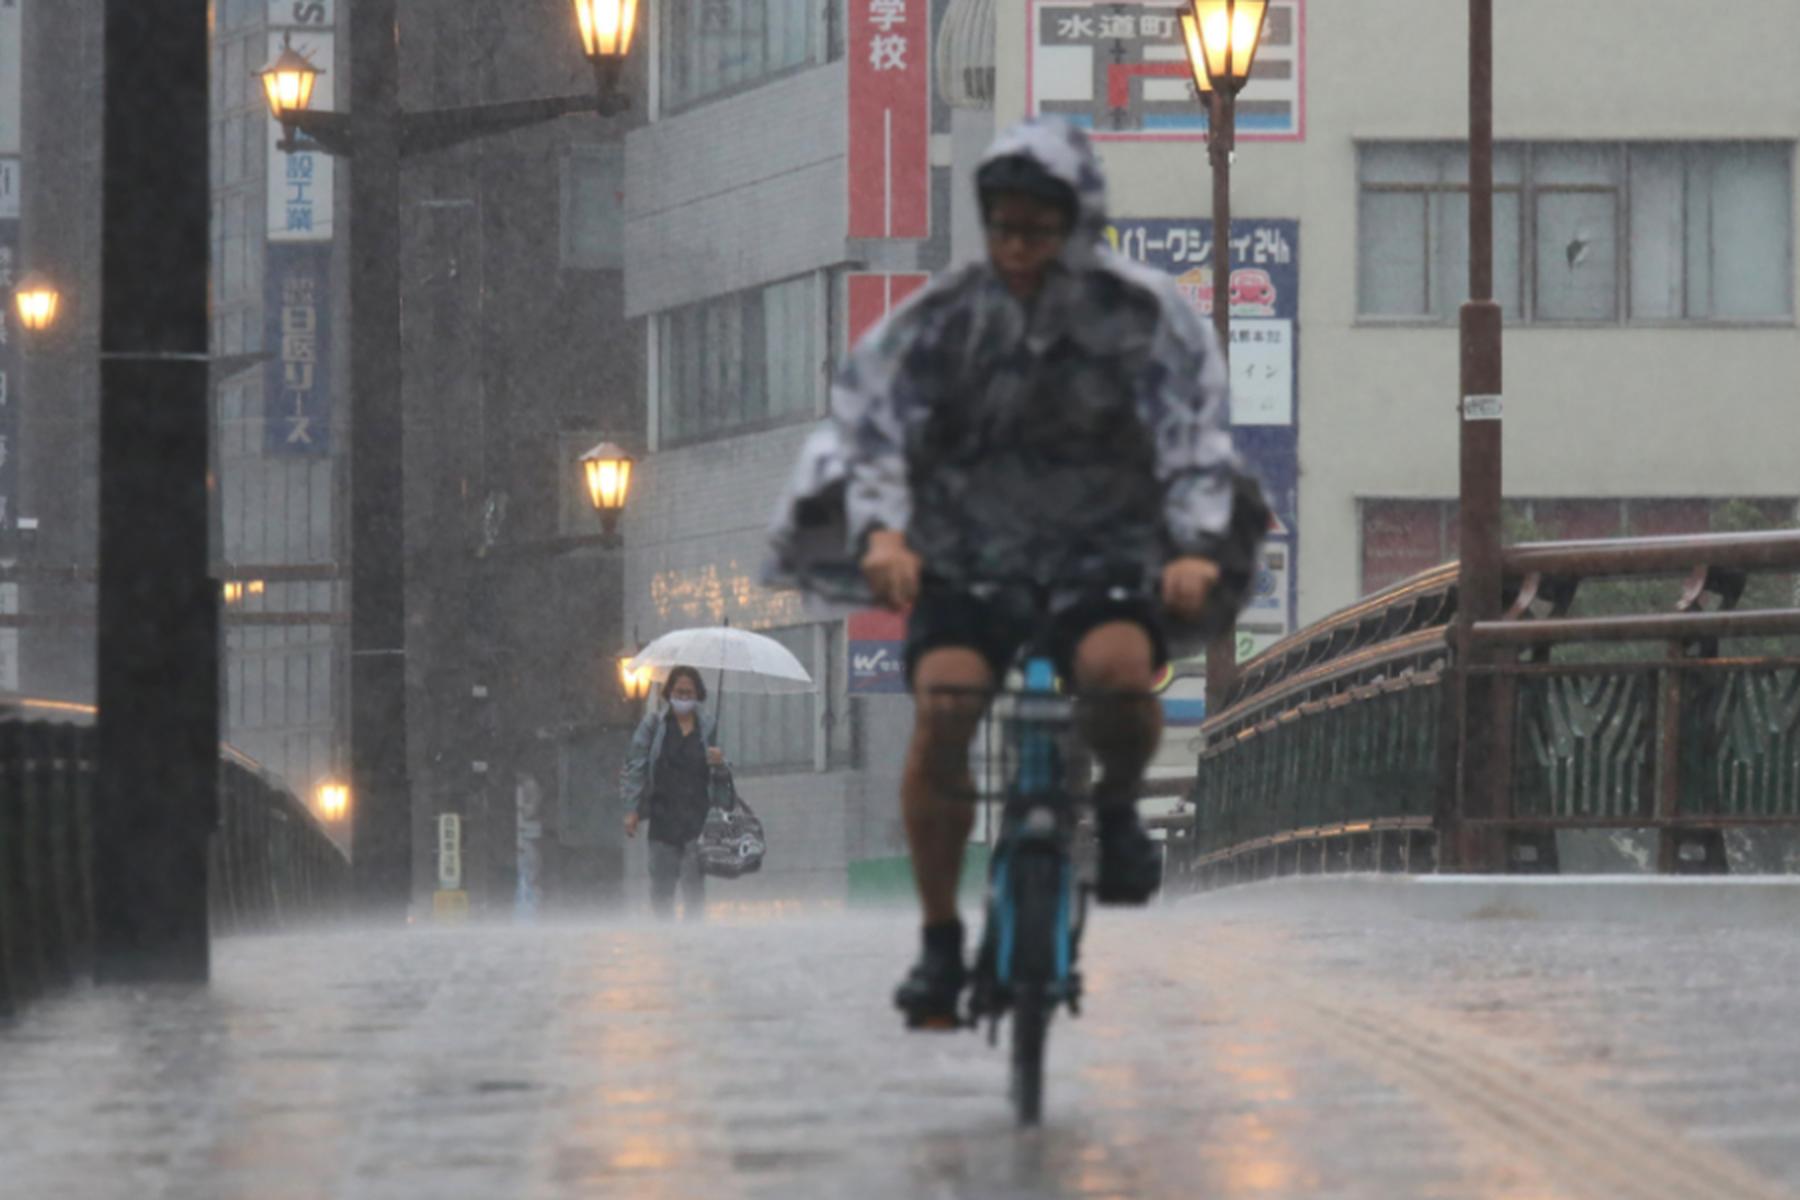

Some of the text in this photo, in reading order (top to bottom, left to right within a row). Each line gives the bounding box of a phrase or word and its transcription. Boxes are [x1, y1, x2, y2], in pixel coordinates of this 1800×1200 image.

[868, 0, 908, 71] 学校
[1057, 14, 1177, 39] 水道町
